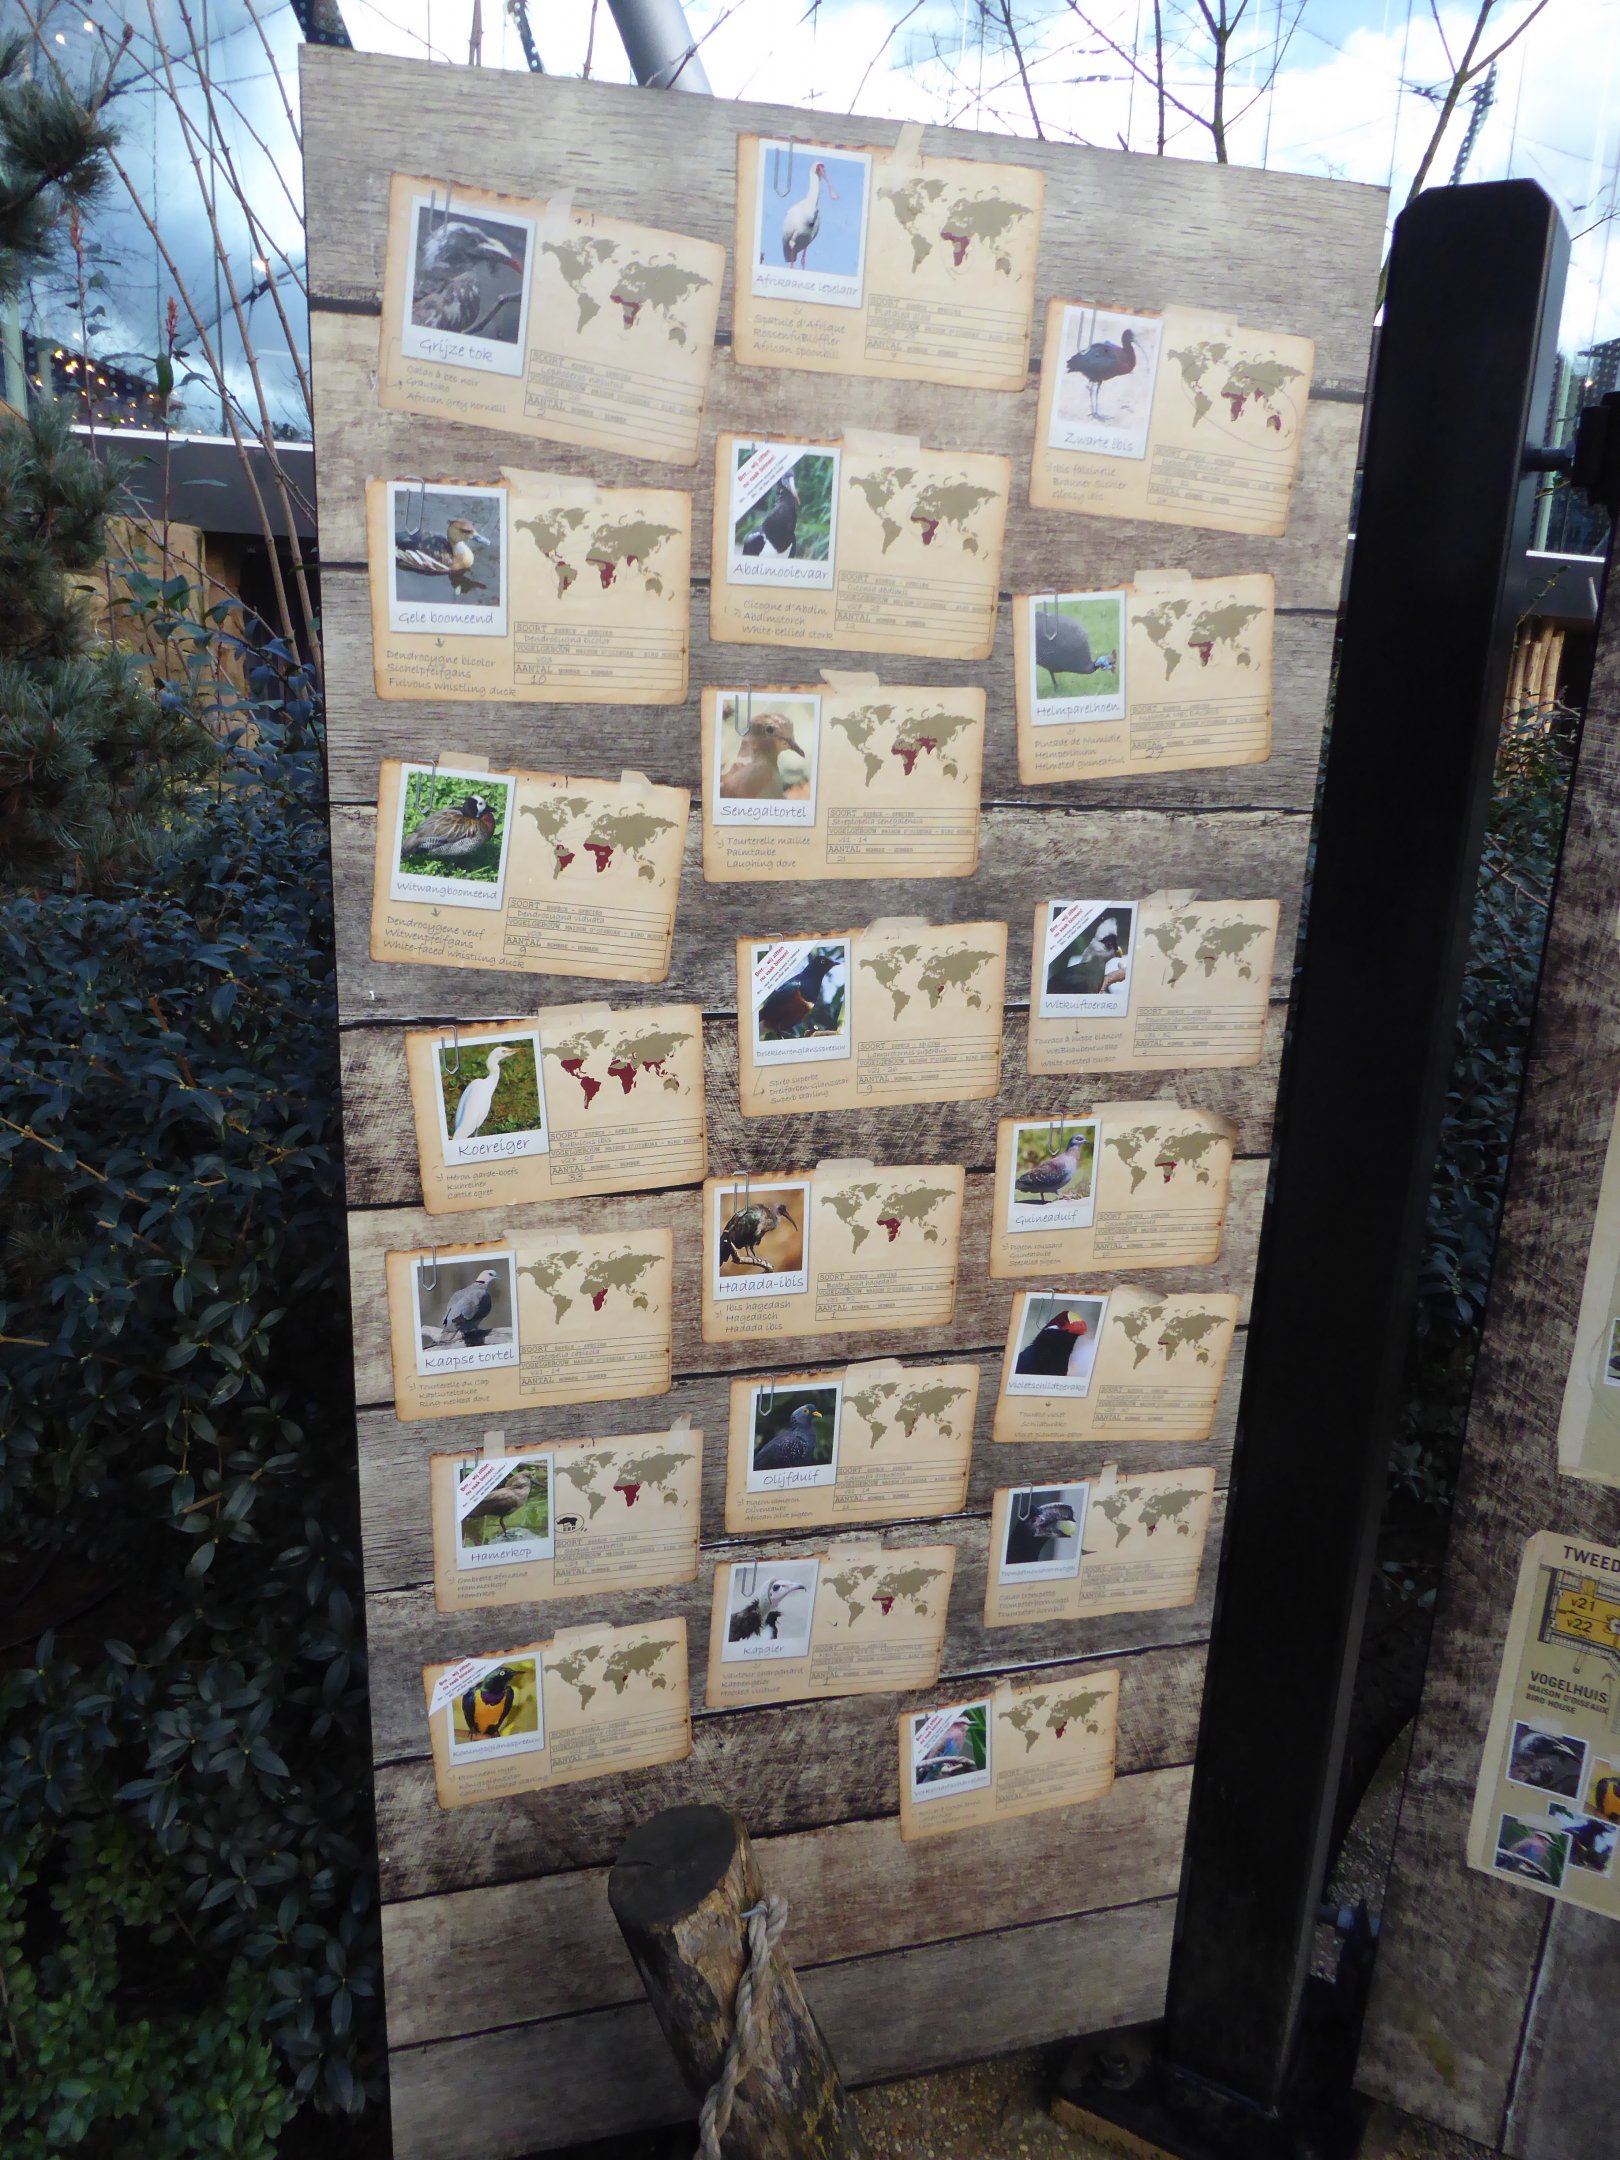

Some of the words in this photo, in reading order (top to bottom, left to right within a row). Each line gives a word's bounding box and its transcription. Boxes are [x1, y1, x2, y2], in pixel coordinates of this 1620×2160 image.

[419, 338, 465, 360] Grijze
[469, 347, 494, 362] tok
[734, 562, 829, 580] Abdimooievaar
[398, 611, 426, 624] Gele
[430, 611, 494, 625] boomeend
[516, 623, 547, 634] SOORT
[461, 655, 497, 668] bicolor
[516, 663, 553, 675] AANTAL
[388, 677, 431, 690] Fulvous
[434, 681, 487, 696] whistling
[489, 685, 517, 697] duck
[1036, 703, 1120, 719] Helmparelhoen
[720, 804, 807, 820] Senegaltortel
[830, 809, 857, 818] SOORT
[828, 844, 862, 854] AANTAL
[726, 859, 774, 870] Laughing
[776, 859, 797, 868] dove
[397, 882, 498, 900] Witwangboomeend
[511, 899, 540, 911] SOORT
[385, 928, 474, 949] Witwenpfeifgans
[461, 928, 486, 941] veuf
[506, 936, 541, 948] AANTAL
[383, 939, 445, 956] White-faced
[447, 950, 496, 966] whistling
[499, 957, 525, 969] duck
[860, 1042, 886, 1051] SOORT
[859, 1073, 890, 1083] AANTAL
[550, 1131, 578, 1141] SOORT
[458, 1139, 531, 1157] Koereiger
[552, 1164, 585, 1175] AANTAL
[567, 1173, 584, 1182] 33
[820, 1273, 844, 1281] SOORT
[719, 1275, 804, 1293] Hadada-ibis
[726, 1303, 744, 1312] Ibis
[746, 1300, 791, 1312] hagedash
[818, 1304, 847, 1312] AANTAL
[726, 1311, 778, 1324] Hagedasch
[725, 1323, 763, 1333] Hadada
[764, 1322, 784, 1331] ibis
[521, 1345, 548, 1354] SOORT
[425, 1354, 475, 1369] Kaapse
[477, 1348, 515, 1361] tortel
[521, 1376, 554, 1385] AANTAL
[763, 1469, 820, 1488] Olijfduif
[835, 1495, 863, 1503] AANTAL
[471, 1547, 534, 1562] Hamerkop
[1563, 1545, 1620, 1573] TWEED
[1571, 1597, 1596, 1612] v21
[1567, 1619, 1593, 1634] v22
[1528, 1684, 1561, 1700] MAISON
[1531, 1672, 1610, 1704] VOGELHUIS
[1526, 1692, 1546, 1705] BIRD
[1548, 1699, 1577, 1714] HOUSE
